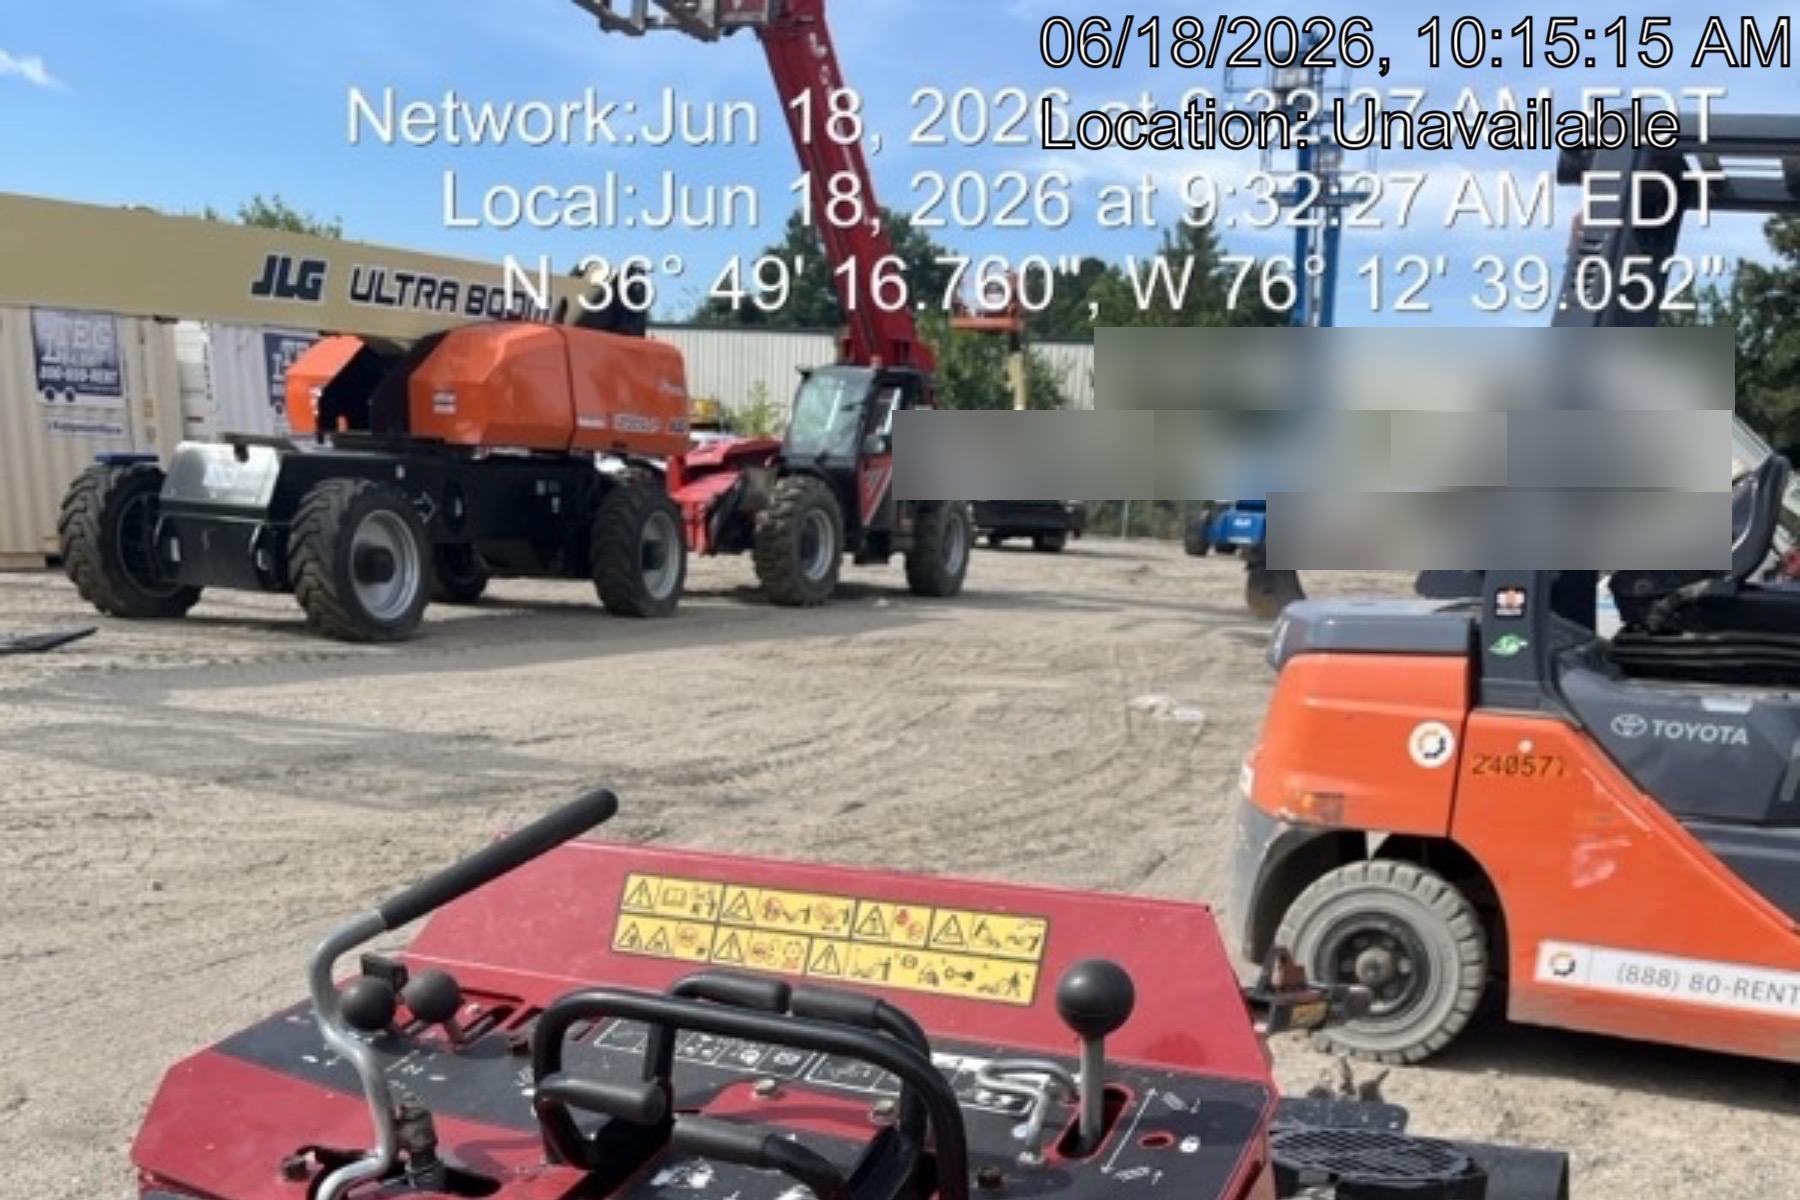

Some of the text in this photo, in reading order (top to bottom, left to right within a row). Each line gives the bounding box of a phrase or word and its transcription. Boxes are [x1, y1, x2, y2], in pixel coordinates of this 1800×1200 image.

[251, 255, 327, 301] JLG
[350, 267, 458, 314] ULTRA
[1652, 719, 1749, 746] TOYOTA
[1616, 962, 1680, 992] (888)
